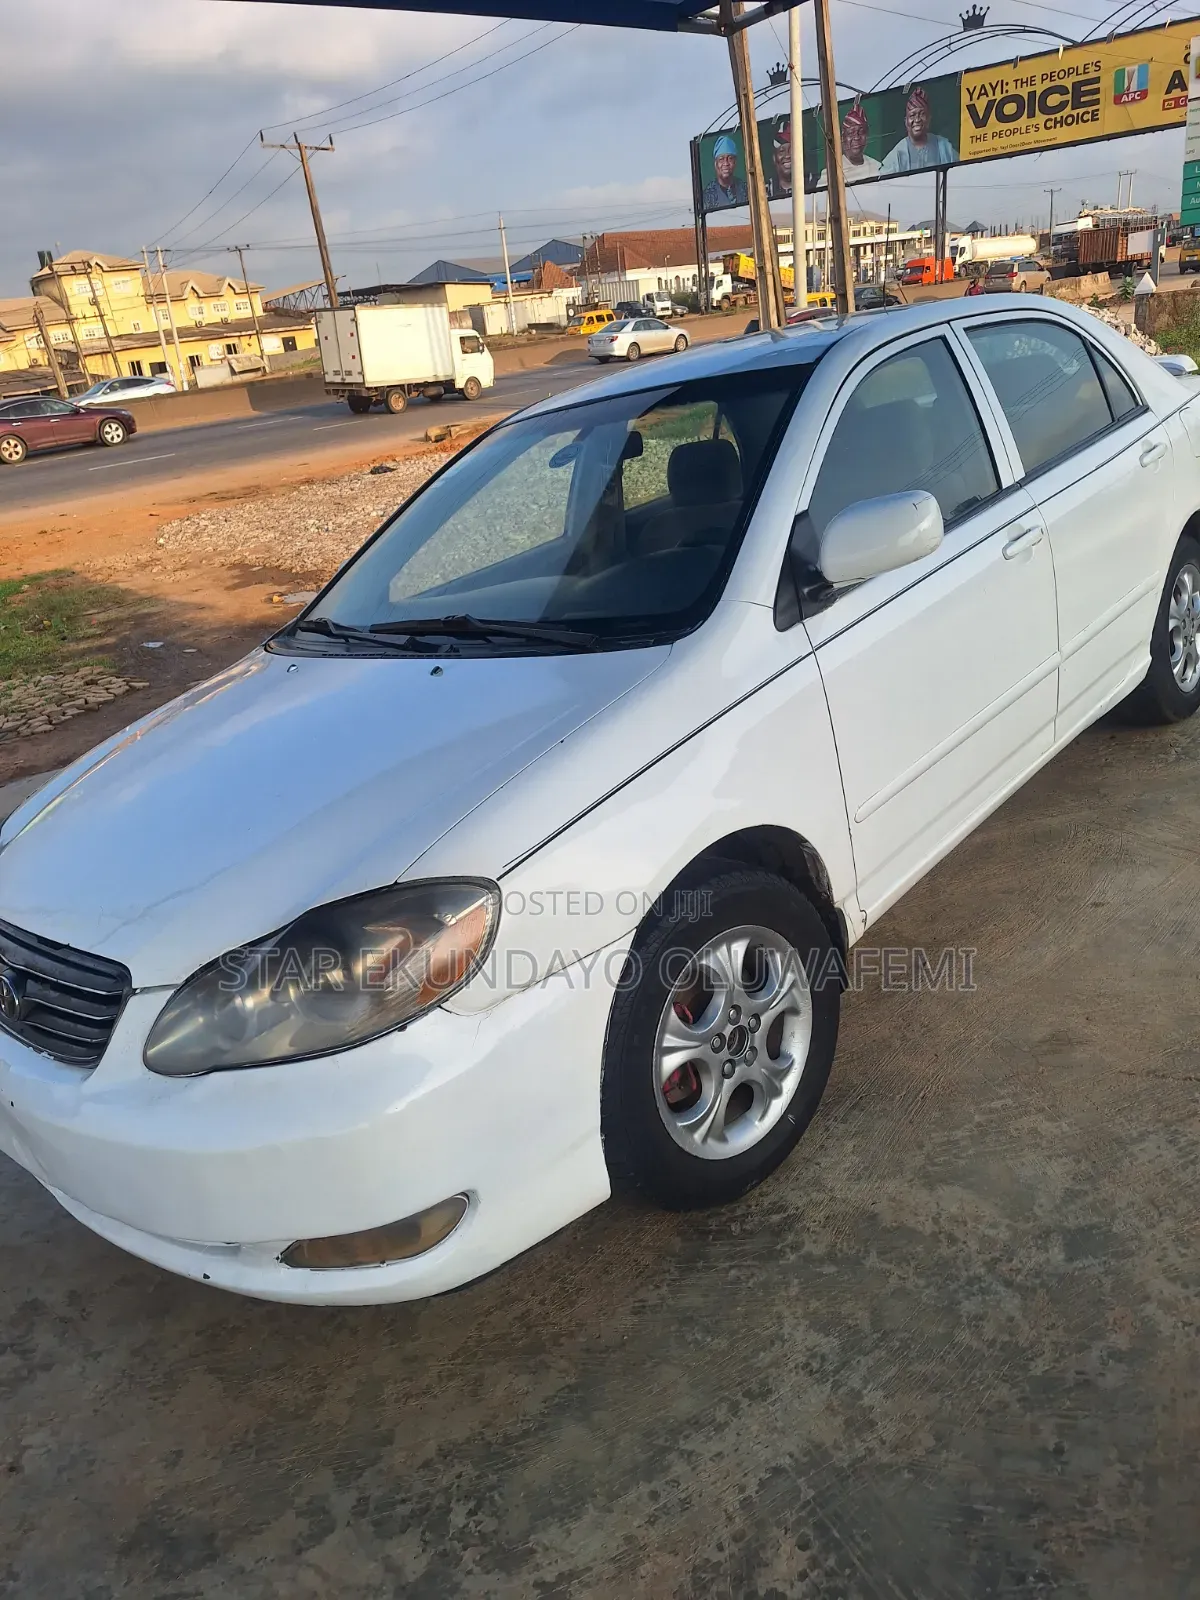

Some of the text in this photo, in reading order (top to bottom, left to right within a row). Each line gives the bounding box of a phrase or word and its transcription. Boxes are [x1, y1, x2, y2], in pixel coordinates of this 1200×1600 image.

[966, 60, 1102, 102] YAYI: THE PEOPLE'S
[1120, 91, 1142, 103] APC
[965, 76, 1101, 129] VOICE
[969, 108, 1100, 145] THE PEOPLE'S CHOICE
